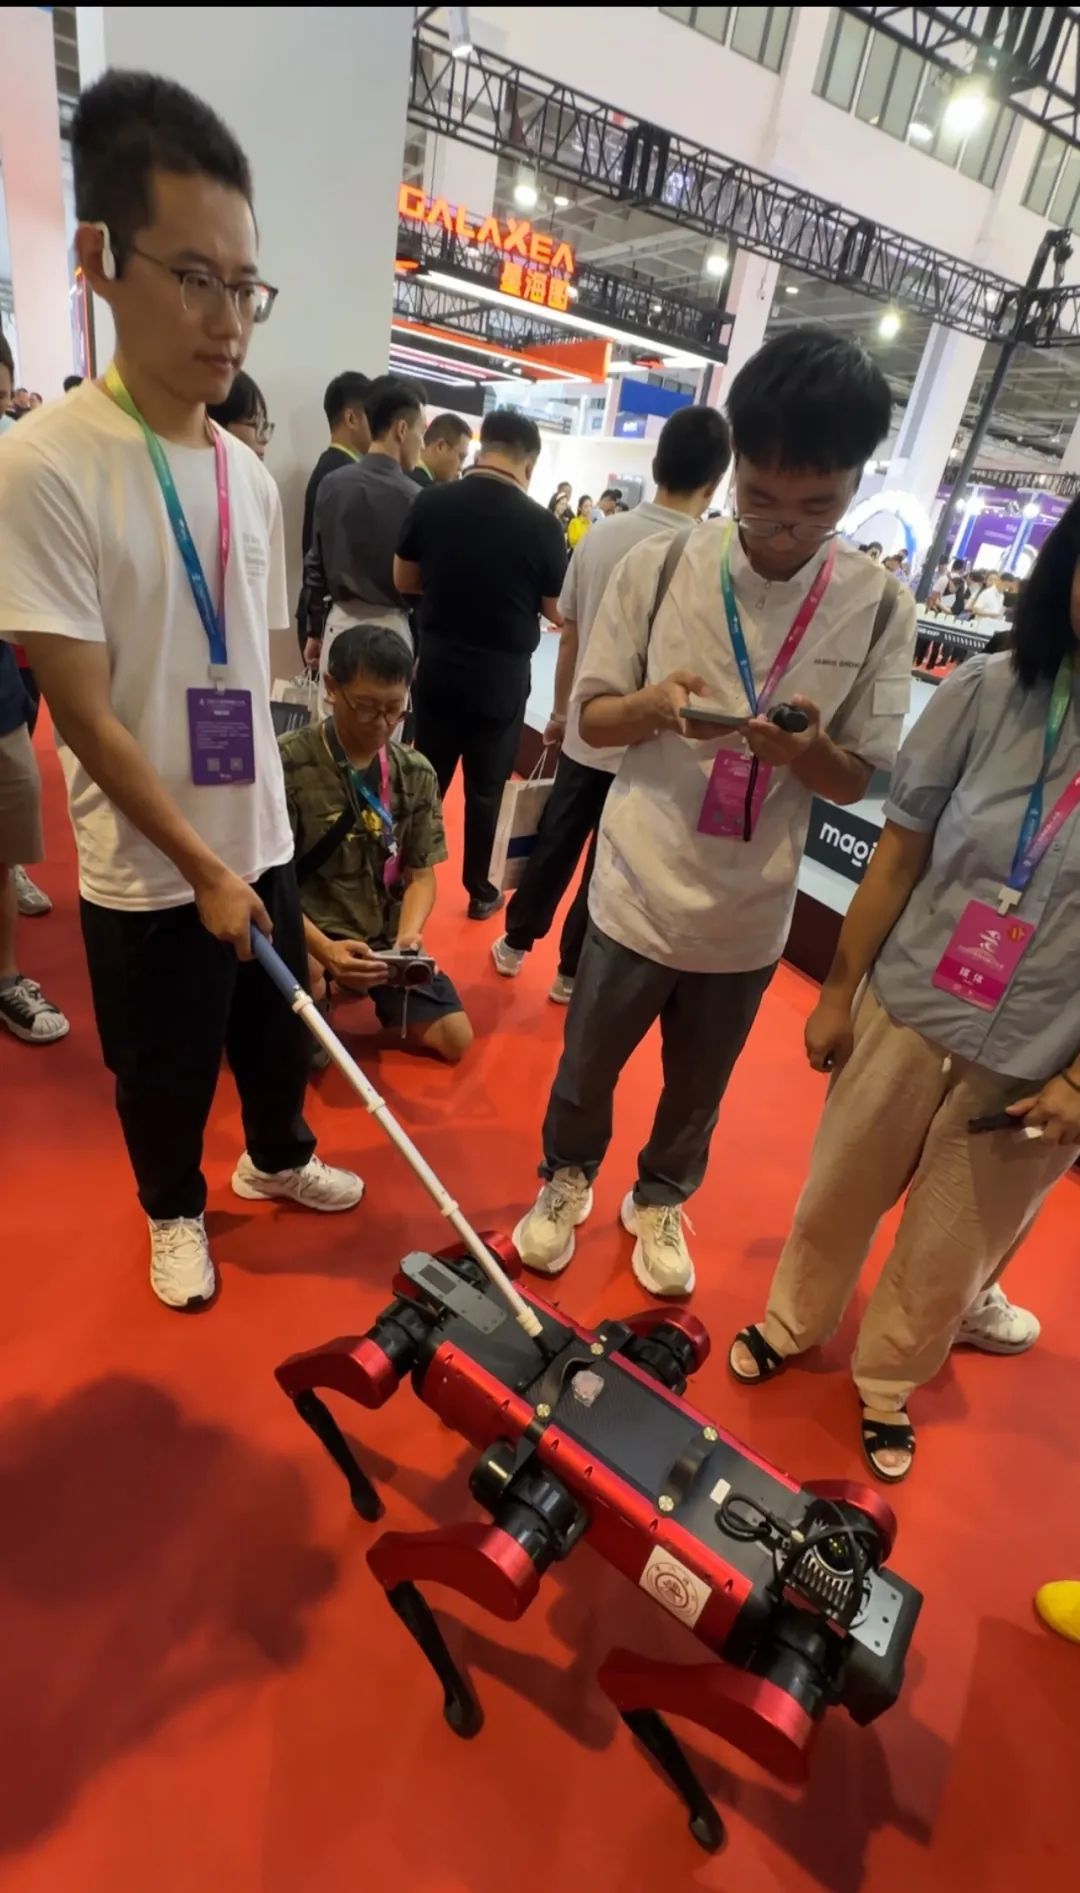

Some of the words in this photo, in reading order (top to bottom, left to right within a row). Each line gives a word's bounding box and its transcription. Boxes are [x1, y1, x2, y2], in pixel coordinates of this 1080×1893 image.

[398, 183, 575, 274] GALAXEA
[499, 260, 571, 312] 星海图
